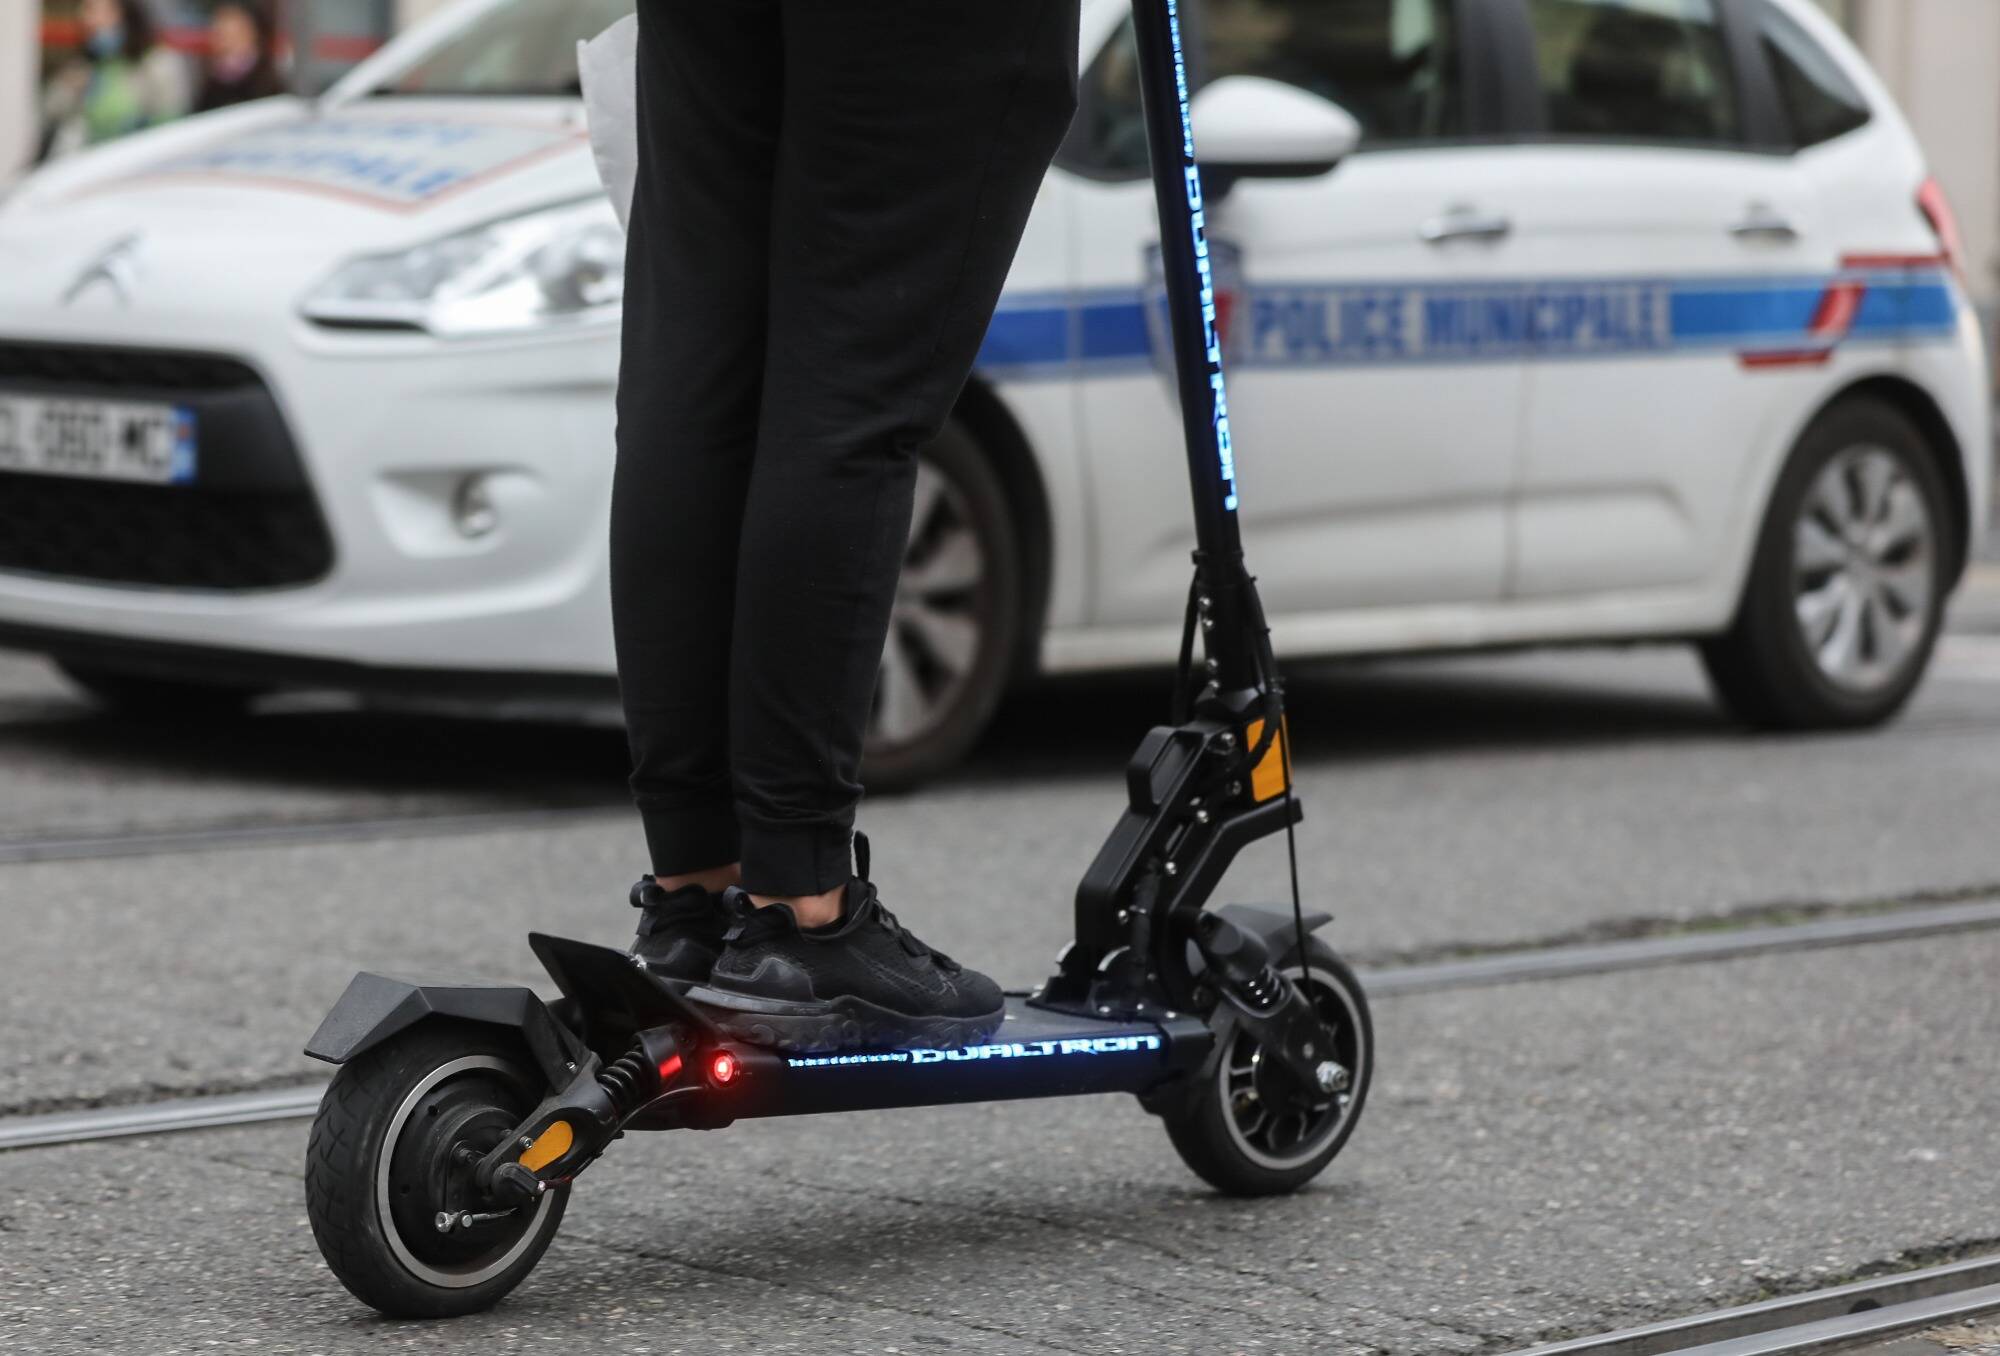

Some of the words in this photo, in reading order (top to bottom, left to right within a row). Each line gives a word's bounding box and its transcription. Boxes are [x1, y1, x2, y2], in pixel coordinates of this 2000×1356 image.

[1252, 293, 1404, 352] POLICE
[1424, 287, 1655, 349] MUNICIPALE
[911, 1035, 1160, 1063] DUALTRON
